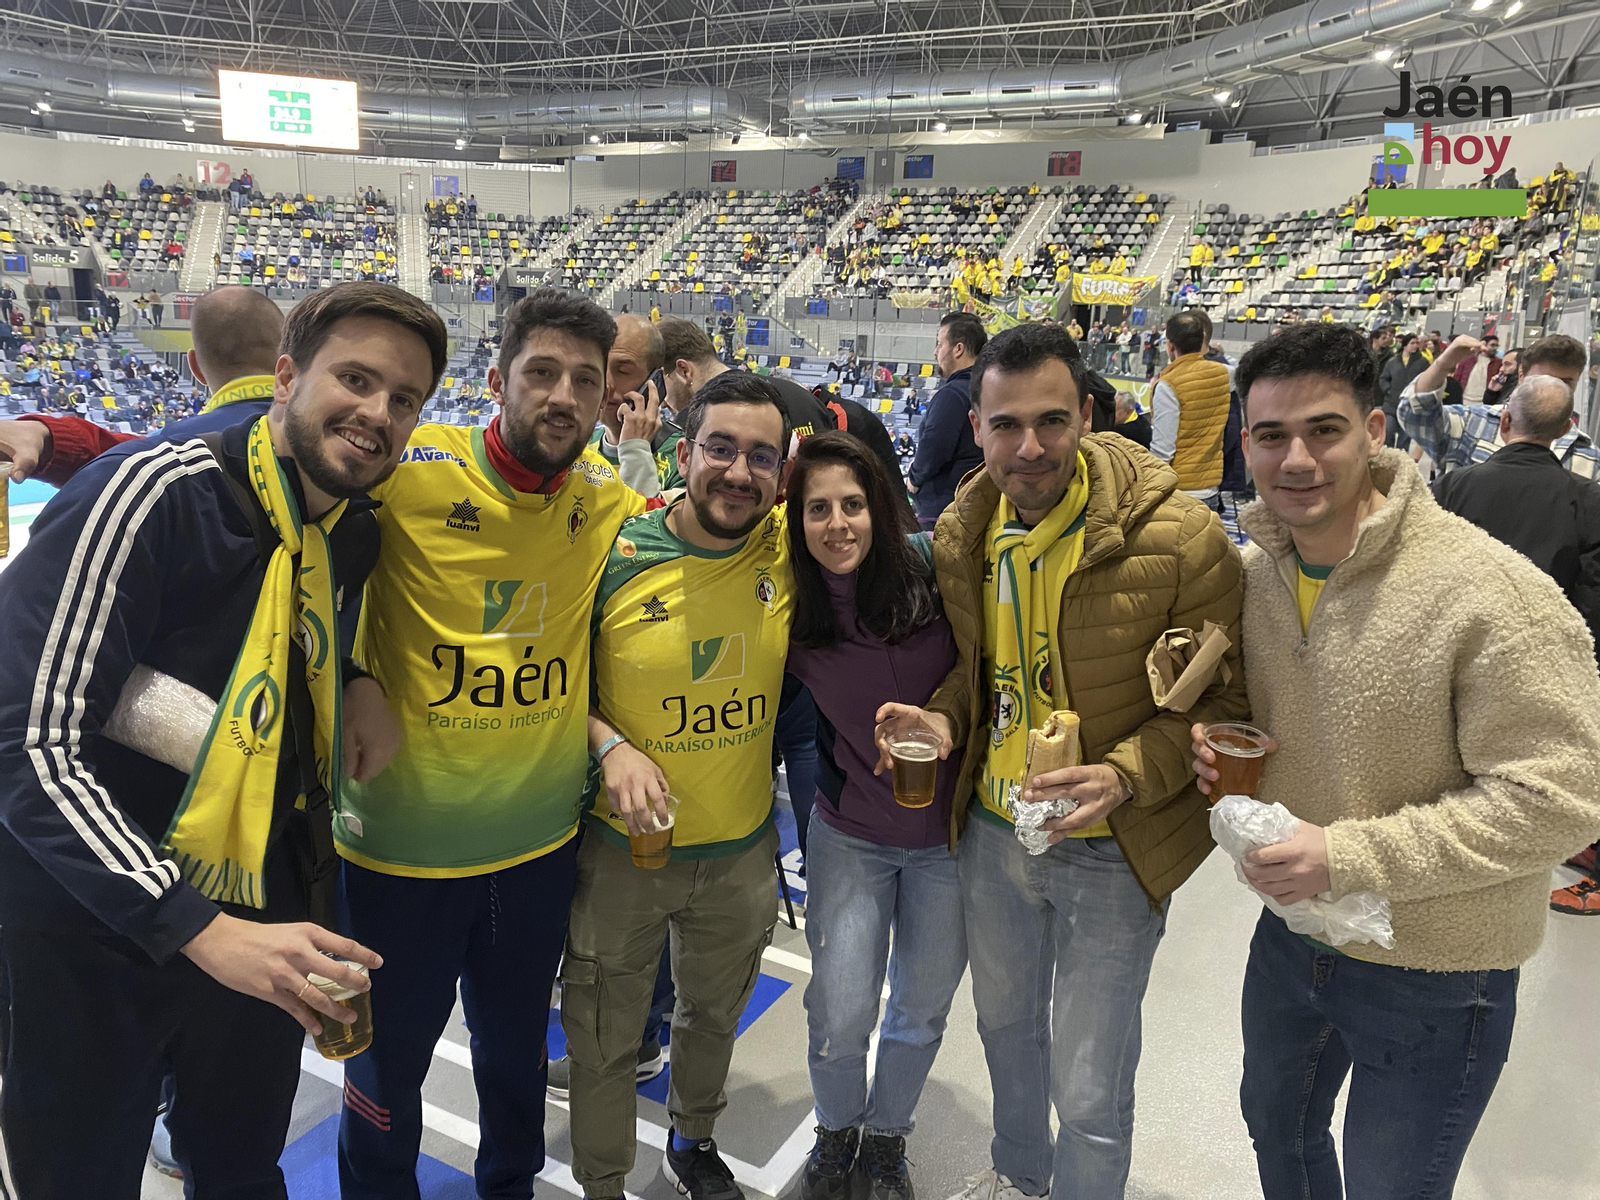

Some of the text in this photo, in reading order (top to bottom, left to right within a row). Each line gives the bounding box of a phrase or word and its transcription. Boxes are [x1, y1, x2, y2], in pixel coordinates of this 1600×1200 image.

[200, 161, 230, 184] 12
[1053, 151, 1081, 176] 18
[33, 250, 79, 264] Salida 5
[516, 274, 539, 284] Salida
[446, 519, 480, 532] luanvi
[608, 561, 631, 575] GREEN
[632, 551, 660, 564] ENERGY
[428, 644, 567, 708] Jaén
[427, 705, 567, 730] Paraíso interior
[662, 687, 766, 738] Jaén
[645, 737, 714, 753] PARAÍSO
